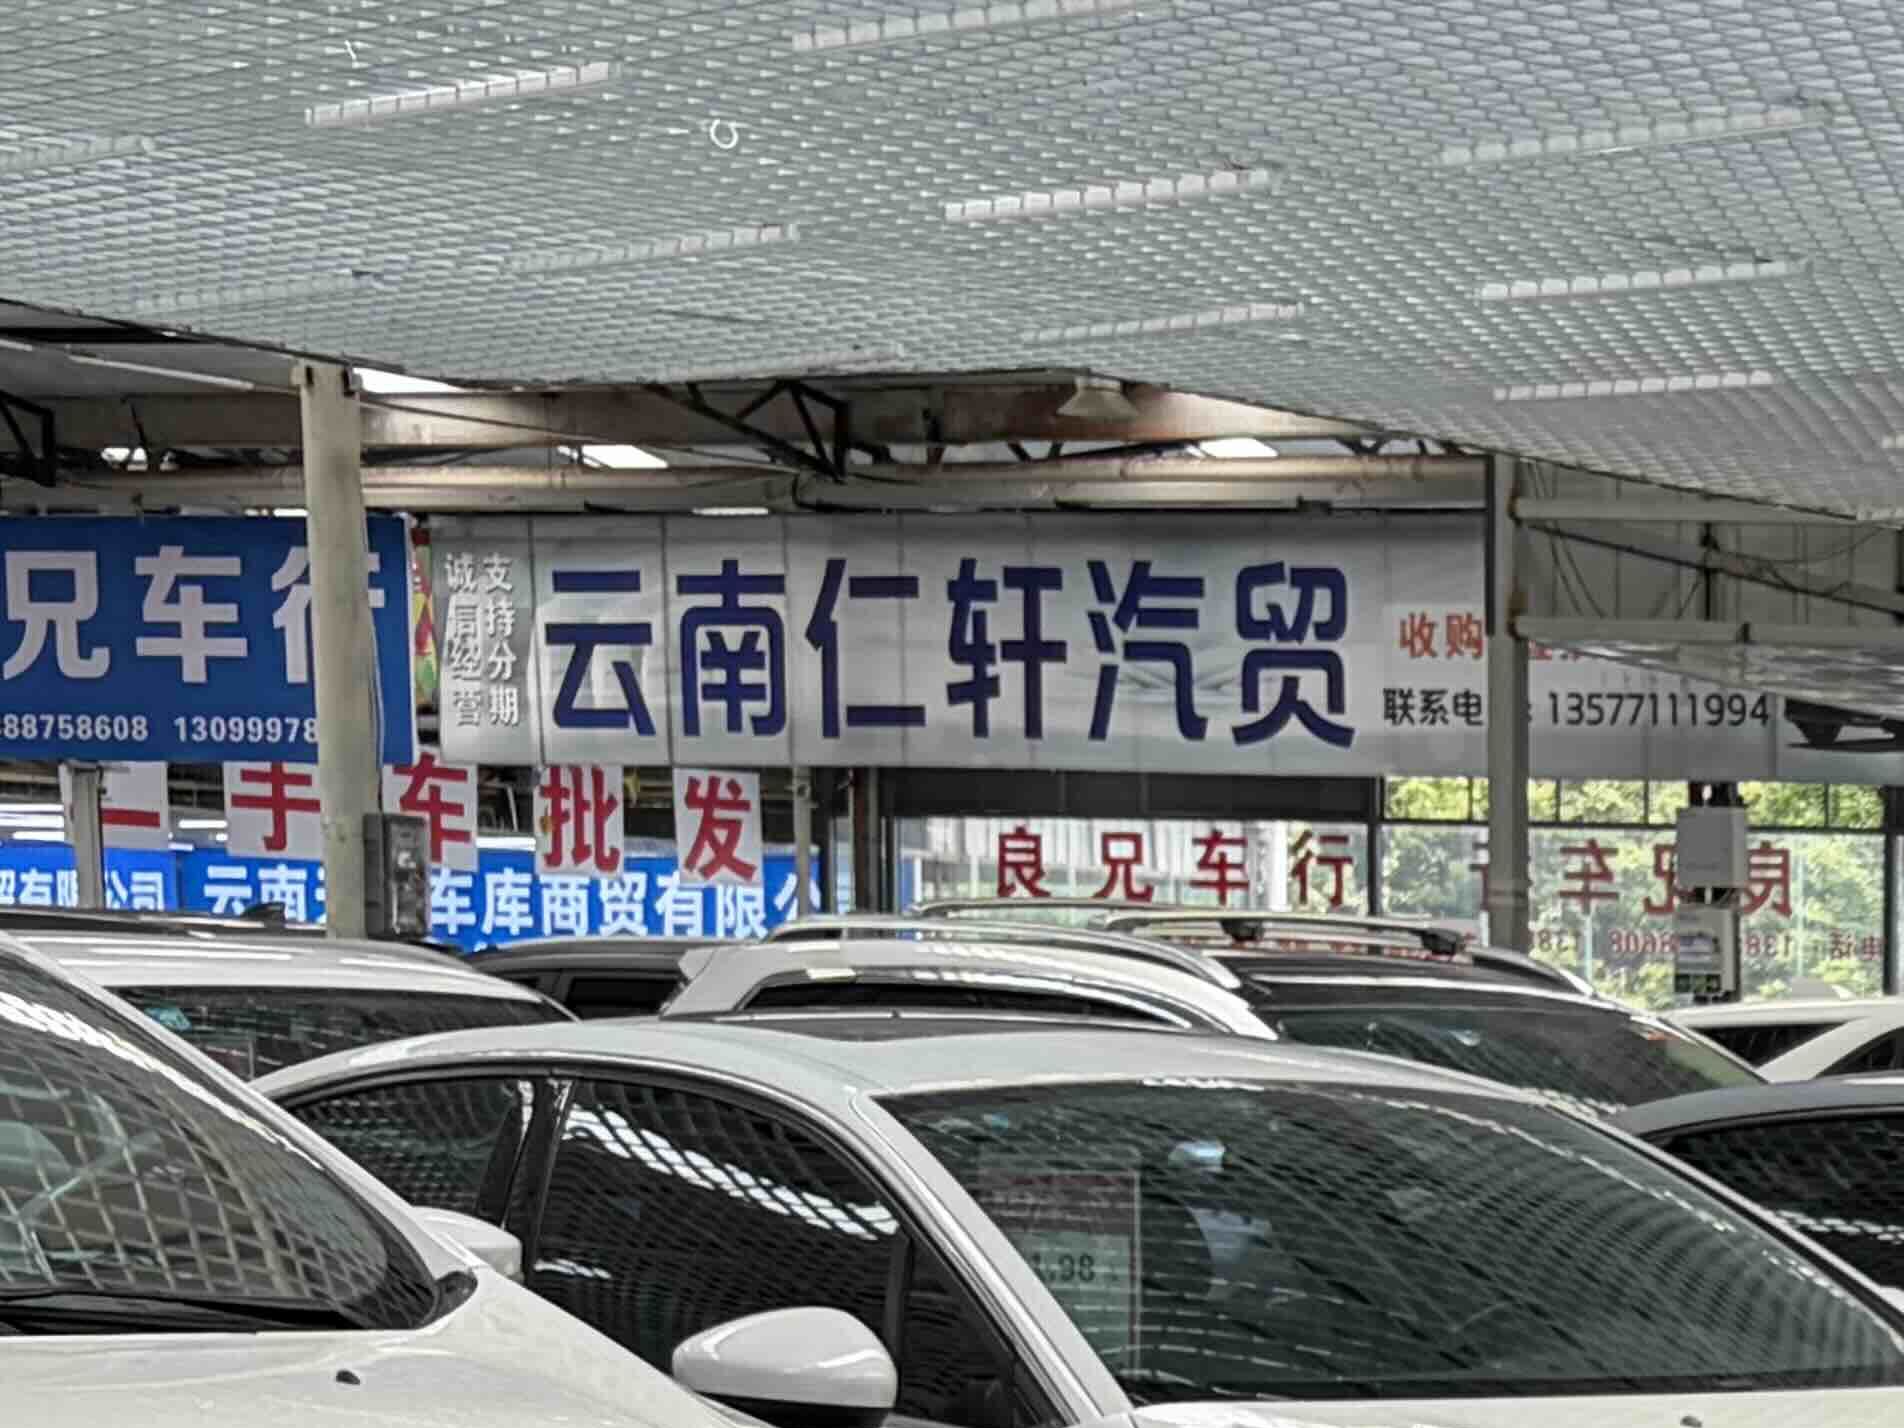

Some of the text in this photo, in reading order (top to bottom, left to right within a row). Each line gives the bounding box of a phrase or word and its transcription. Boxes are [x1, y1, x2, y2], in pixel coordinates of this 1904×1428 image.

[545, 557, 1355, 748] 云南仁轩汽贸
[0, 714, 318, 744] 88758608 13099978
[1549, 691, 1770, 728] 13577111994
[996, 826, 1354, 905] 良兄车行
